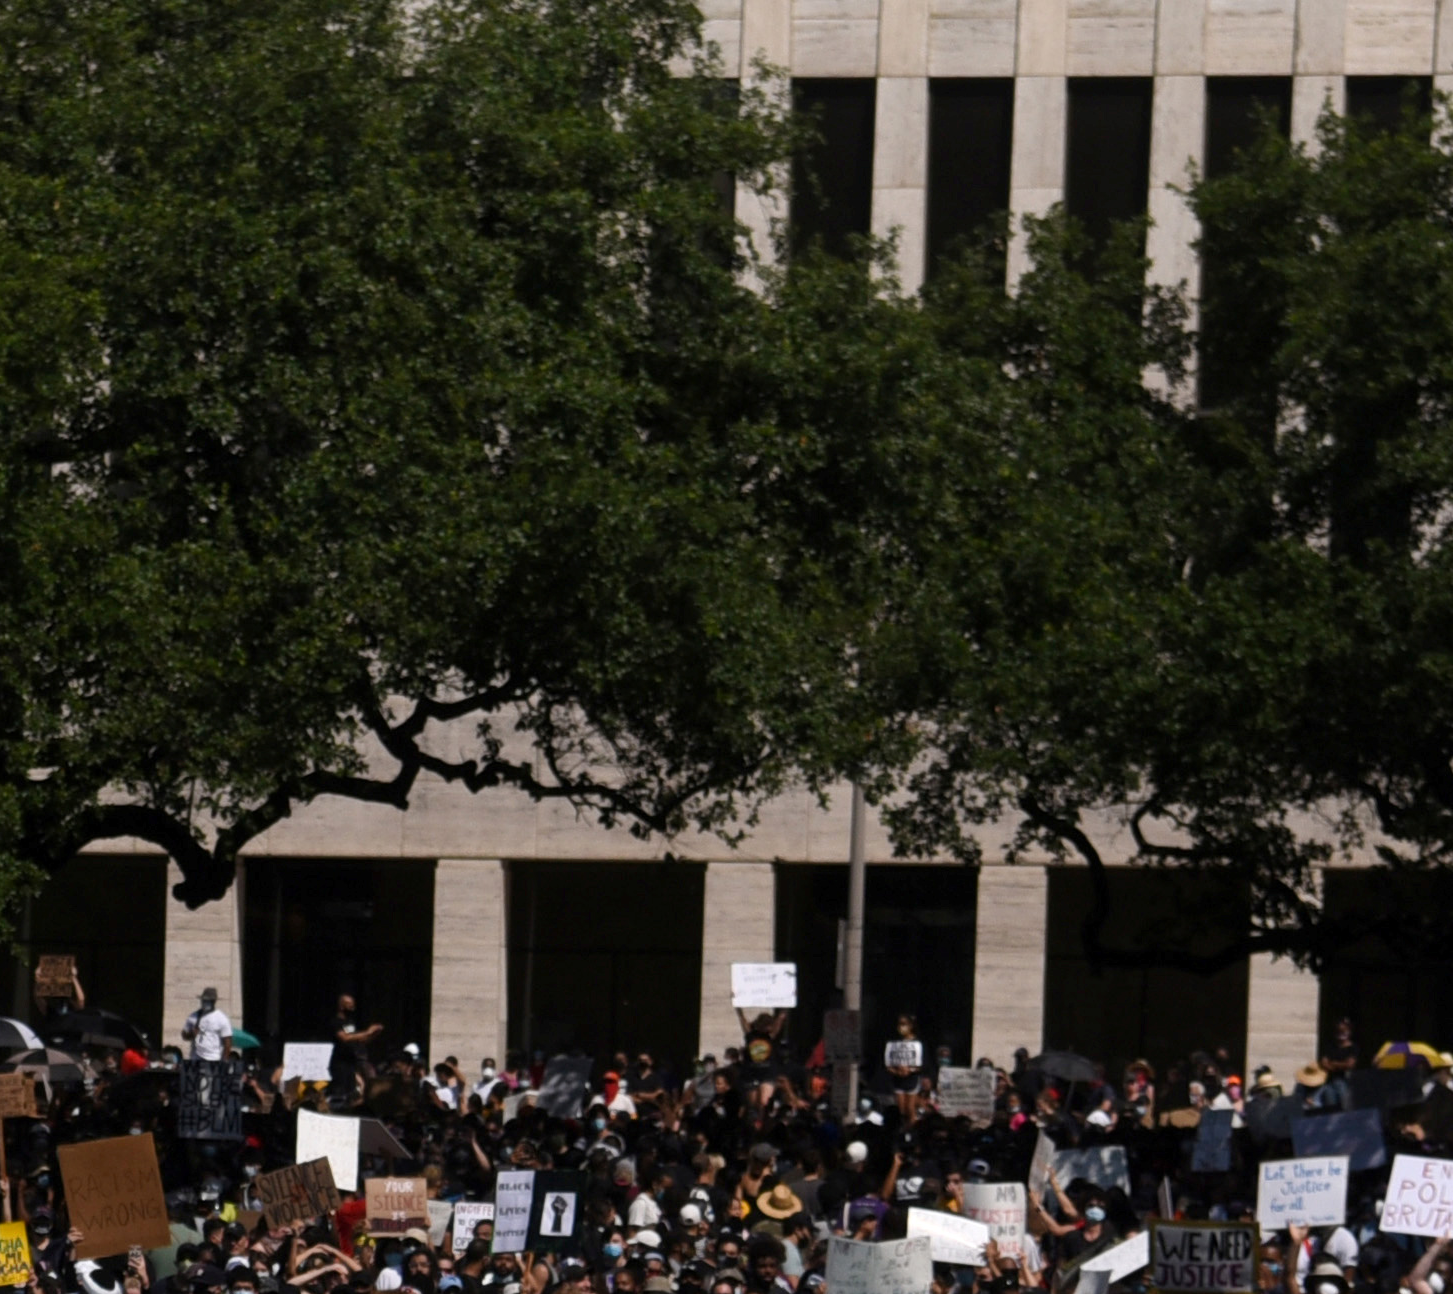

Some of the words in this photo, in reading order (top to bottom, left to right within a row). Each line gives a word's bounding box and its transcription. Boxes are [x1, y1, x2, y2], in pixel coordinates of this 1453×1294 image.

[78, 1202, 161, 1231] WRONG
[1156, 1231, 1205, 1262] WE
[1208, 1228, 1252, 1260] NEED
[1156, 1260, 1245, 1289] JUSTICE
